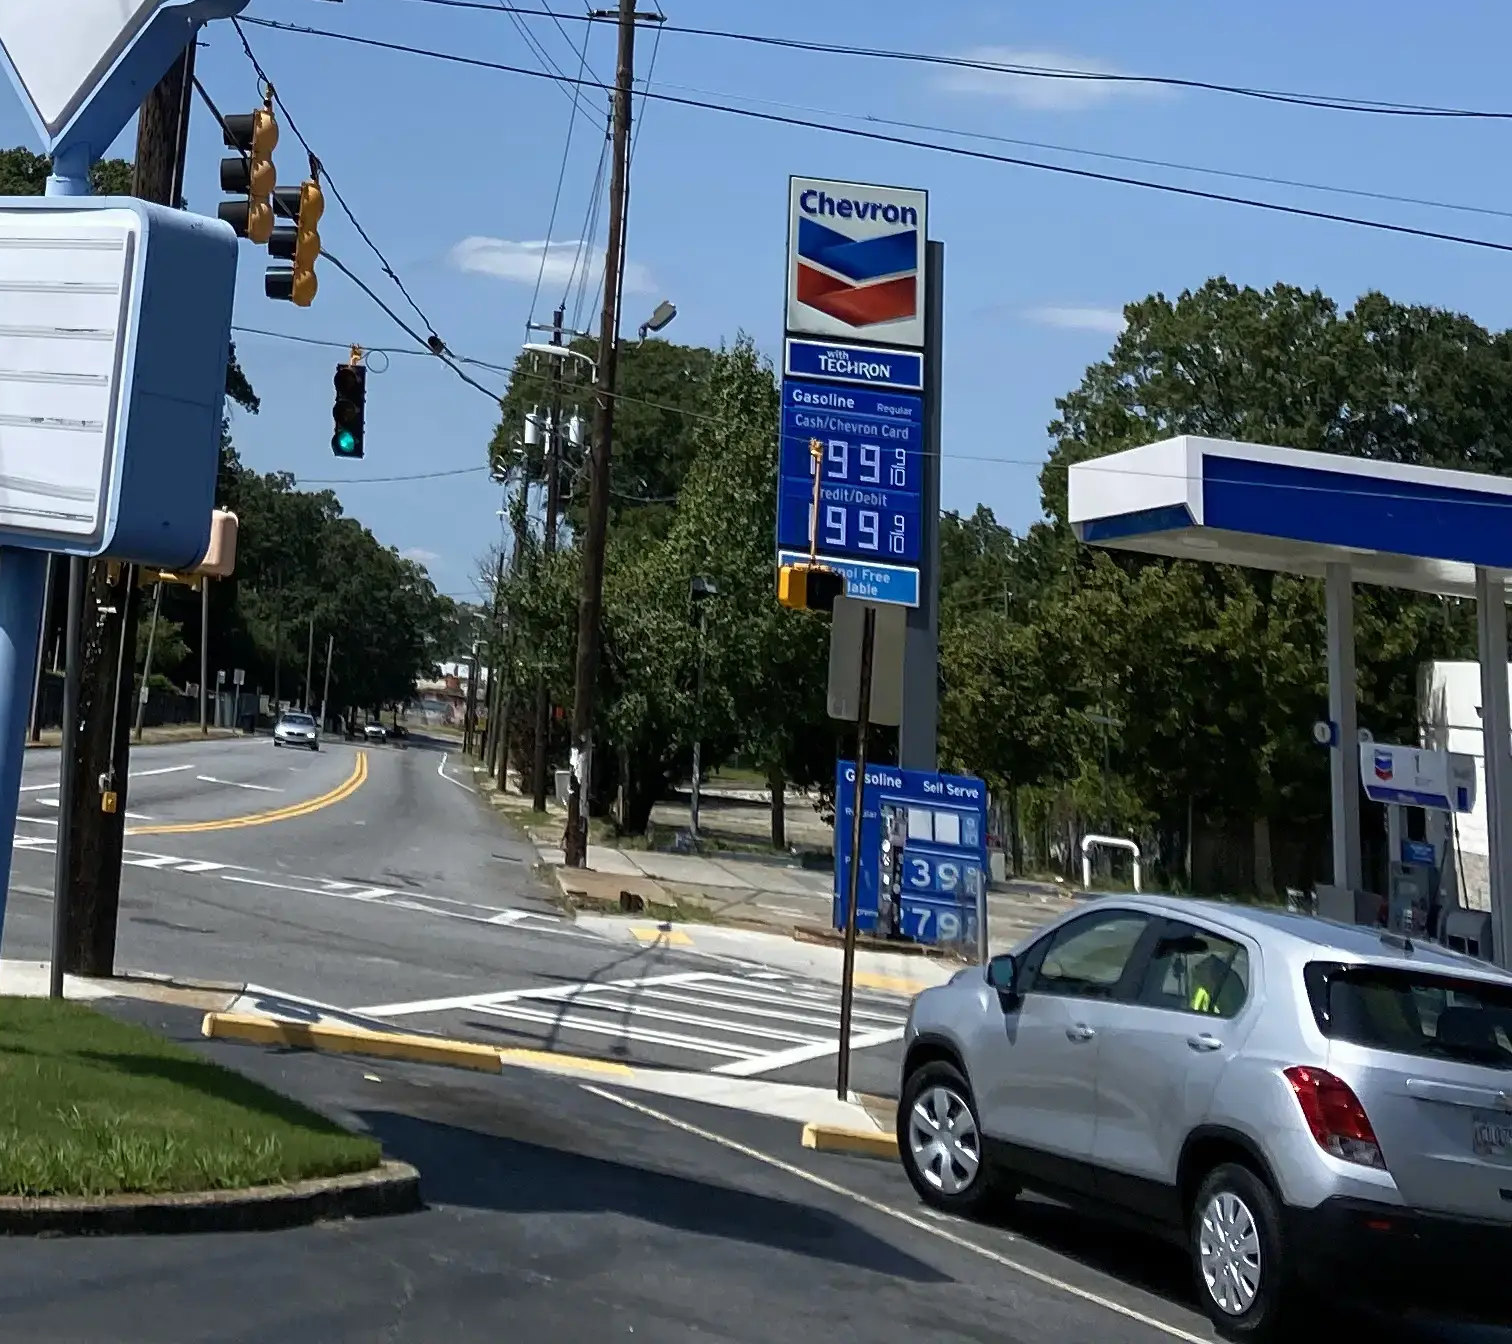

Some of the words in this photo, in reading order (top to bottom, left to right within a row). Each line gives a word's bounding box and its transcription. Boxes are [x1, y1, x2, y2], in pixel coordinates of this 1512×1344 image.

[799, 188, 918, 226] Chevron
[818, 354, 890, 379] TECHRON
[826, 349, 849, 361] with
[792, 389, 855, 409] Gasoline
[876, 402, 912, 416] Regular
[795, 413, 878, 436] Cash/Chevron
[881, 425, 909, 440] Card
[818, 487, 888, 507] redit/Debit
[862, 568, 891, 584] Free
[845, 768, 902, 789] Gsoline
[947, 783, 979, 799] Serve
[910, 859, 960, 891] 39
[899, 906, 960, 939] 79
